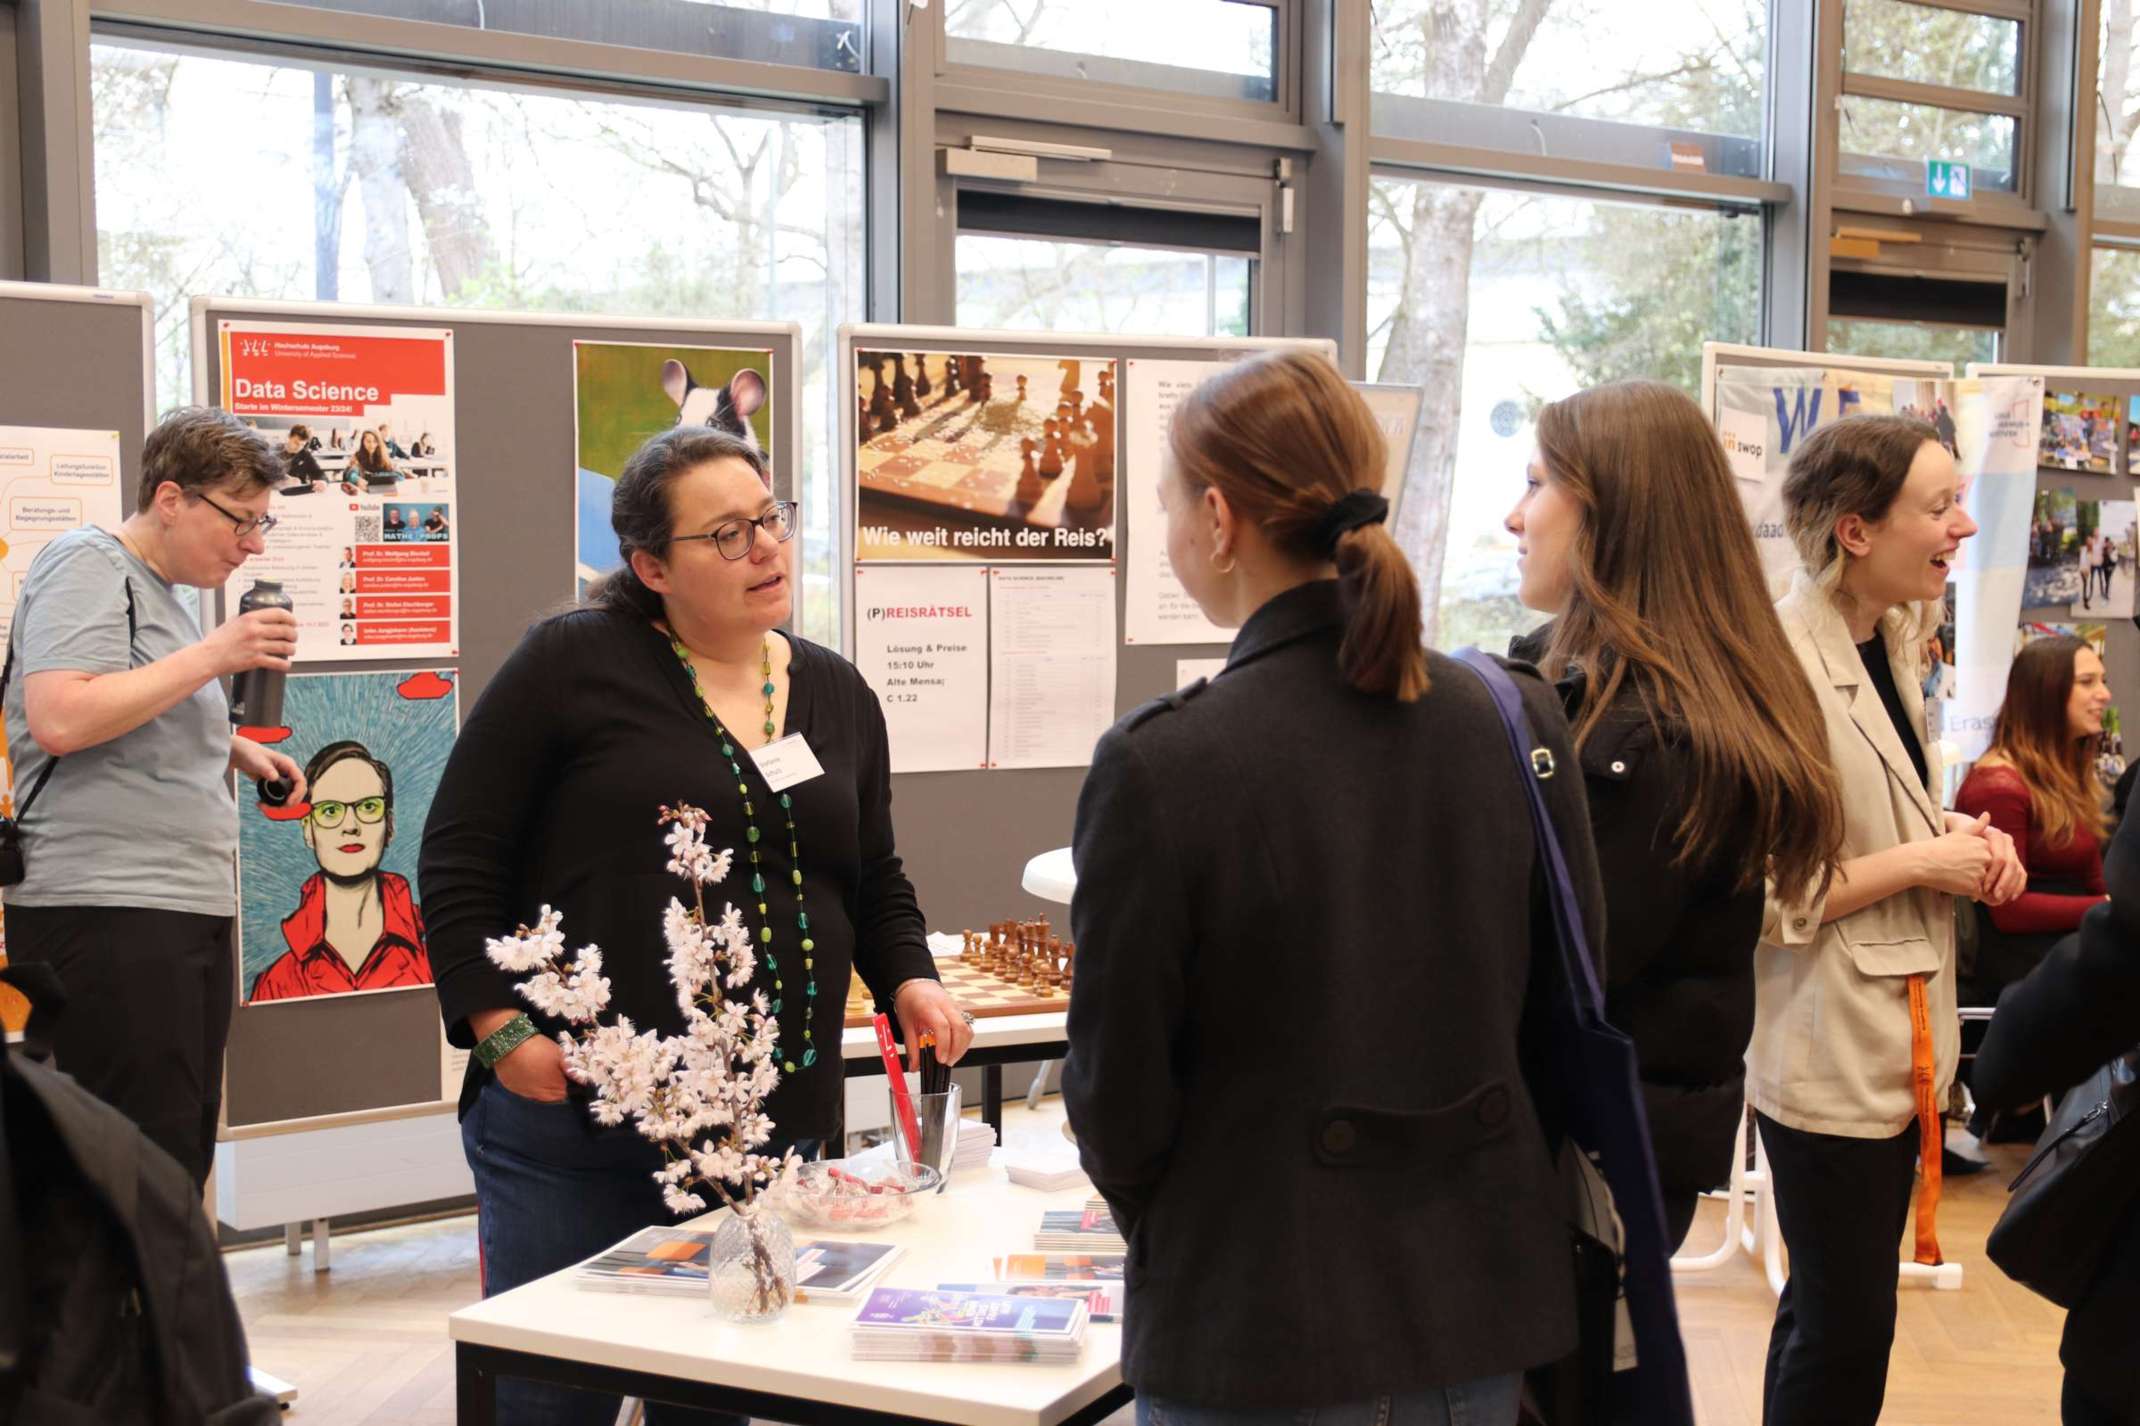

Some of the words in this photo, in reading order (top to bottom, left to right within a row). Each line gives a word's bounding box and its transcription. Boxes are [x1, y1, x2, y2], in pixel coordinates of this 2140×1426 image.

[235, 379, 286, 399] Data
[292, 380, 379, 401] Science
[863, 526, 901, 546] Wie
[906, 526, 948, 546] weit
[953, 527, 1011, 546] reicht
[1015, 527, 1049, 546] der
[1054, 528, 1107, 546] Reis?
[867, 606, 973, 621] (P)REISRÄTSEL
[887, 644, 923, 654] Lösung
[937, 644, 968, 652] Preise
[888, 662, 914, 670] 15:10
[917, 661, 934, 669] Uhr
[887, 678, 906, 687] Alte
[887, 695, 894, 703] C
[897, 694, 918, 702] 1.22
[1951, 714, 1995, 732] Eras
